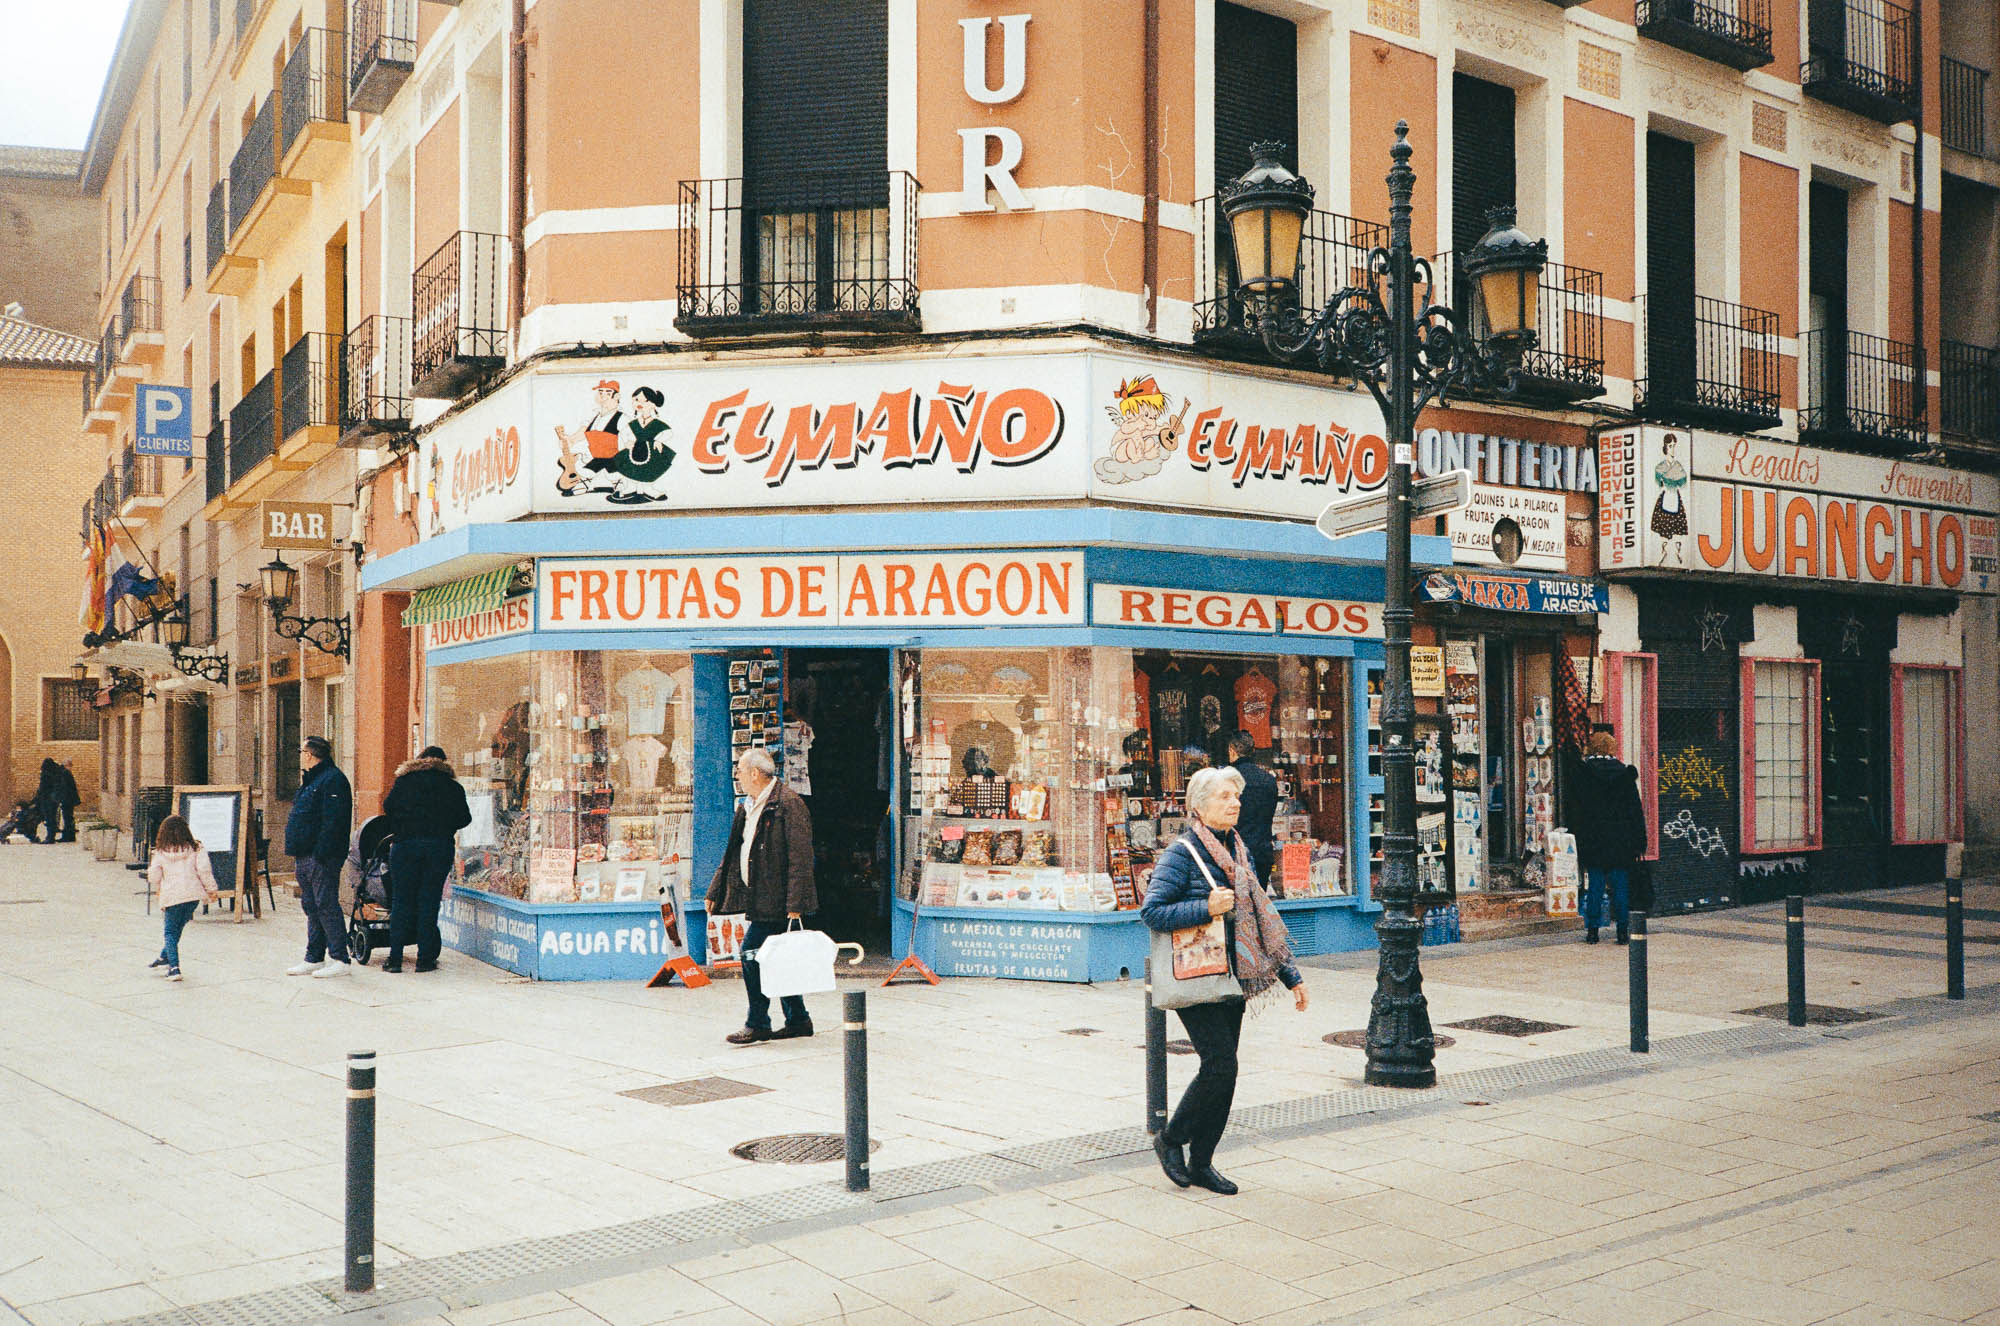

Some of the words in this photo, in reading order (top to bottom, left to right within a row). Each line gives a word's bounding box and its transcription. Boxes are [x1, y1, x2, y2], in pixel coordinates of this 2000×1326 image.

[145, 390, 183, 434] P
[764, 380, 1065, 488] MAÑO
[138, 437, 191, 452] CLIENTES
[1231, 421, 1389, 494] MAÑO
[1411, 427, 1597, 492] ONFITERIA
[1725, 438, 1820, 485] Regalos
[1509, 496, 1519, 509] LA
[1524, 498, 1559, 514] PILARICA
[1599, 437, 1612, 536] REGALOS
[1623, 433, 1635, 549] JUGUETES
[269, 511, 326, 540] BAR
[1457, 532, 1468, 544] EN
[1471, 533, 1490, 546] CASA
[1531, 540, 1555, 552] MEJOR
[1464, 510, 1495, 524] FRUTAS
[1516, 515, 1550, 530] ARAGON
[1697, 486, 1965, 588] JUANCHO
[550, 566, 741, 621] FRUTAS
[760, 565, 828, 619] DE
[844, 561, 1073, 618] ARAGON
[1538, 580, 1579, 596] FRUTAS
[1581, 583, 1594, 598] DE
[430, 597, 529, 646] ADOQUINES
[1119, 590, 1369, 634] REGALOS
[540, 930, 611, 957] AGUA
[962, 924, 1004, 937] MEJOR
[1009, 926, 1023, 937] DE
[1020, 943, 1073, 953] CHOCOLATE
[954, 963, 997, 975] FRUTAS
[1004, 966, 1016, 975] DE
